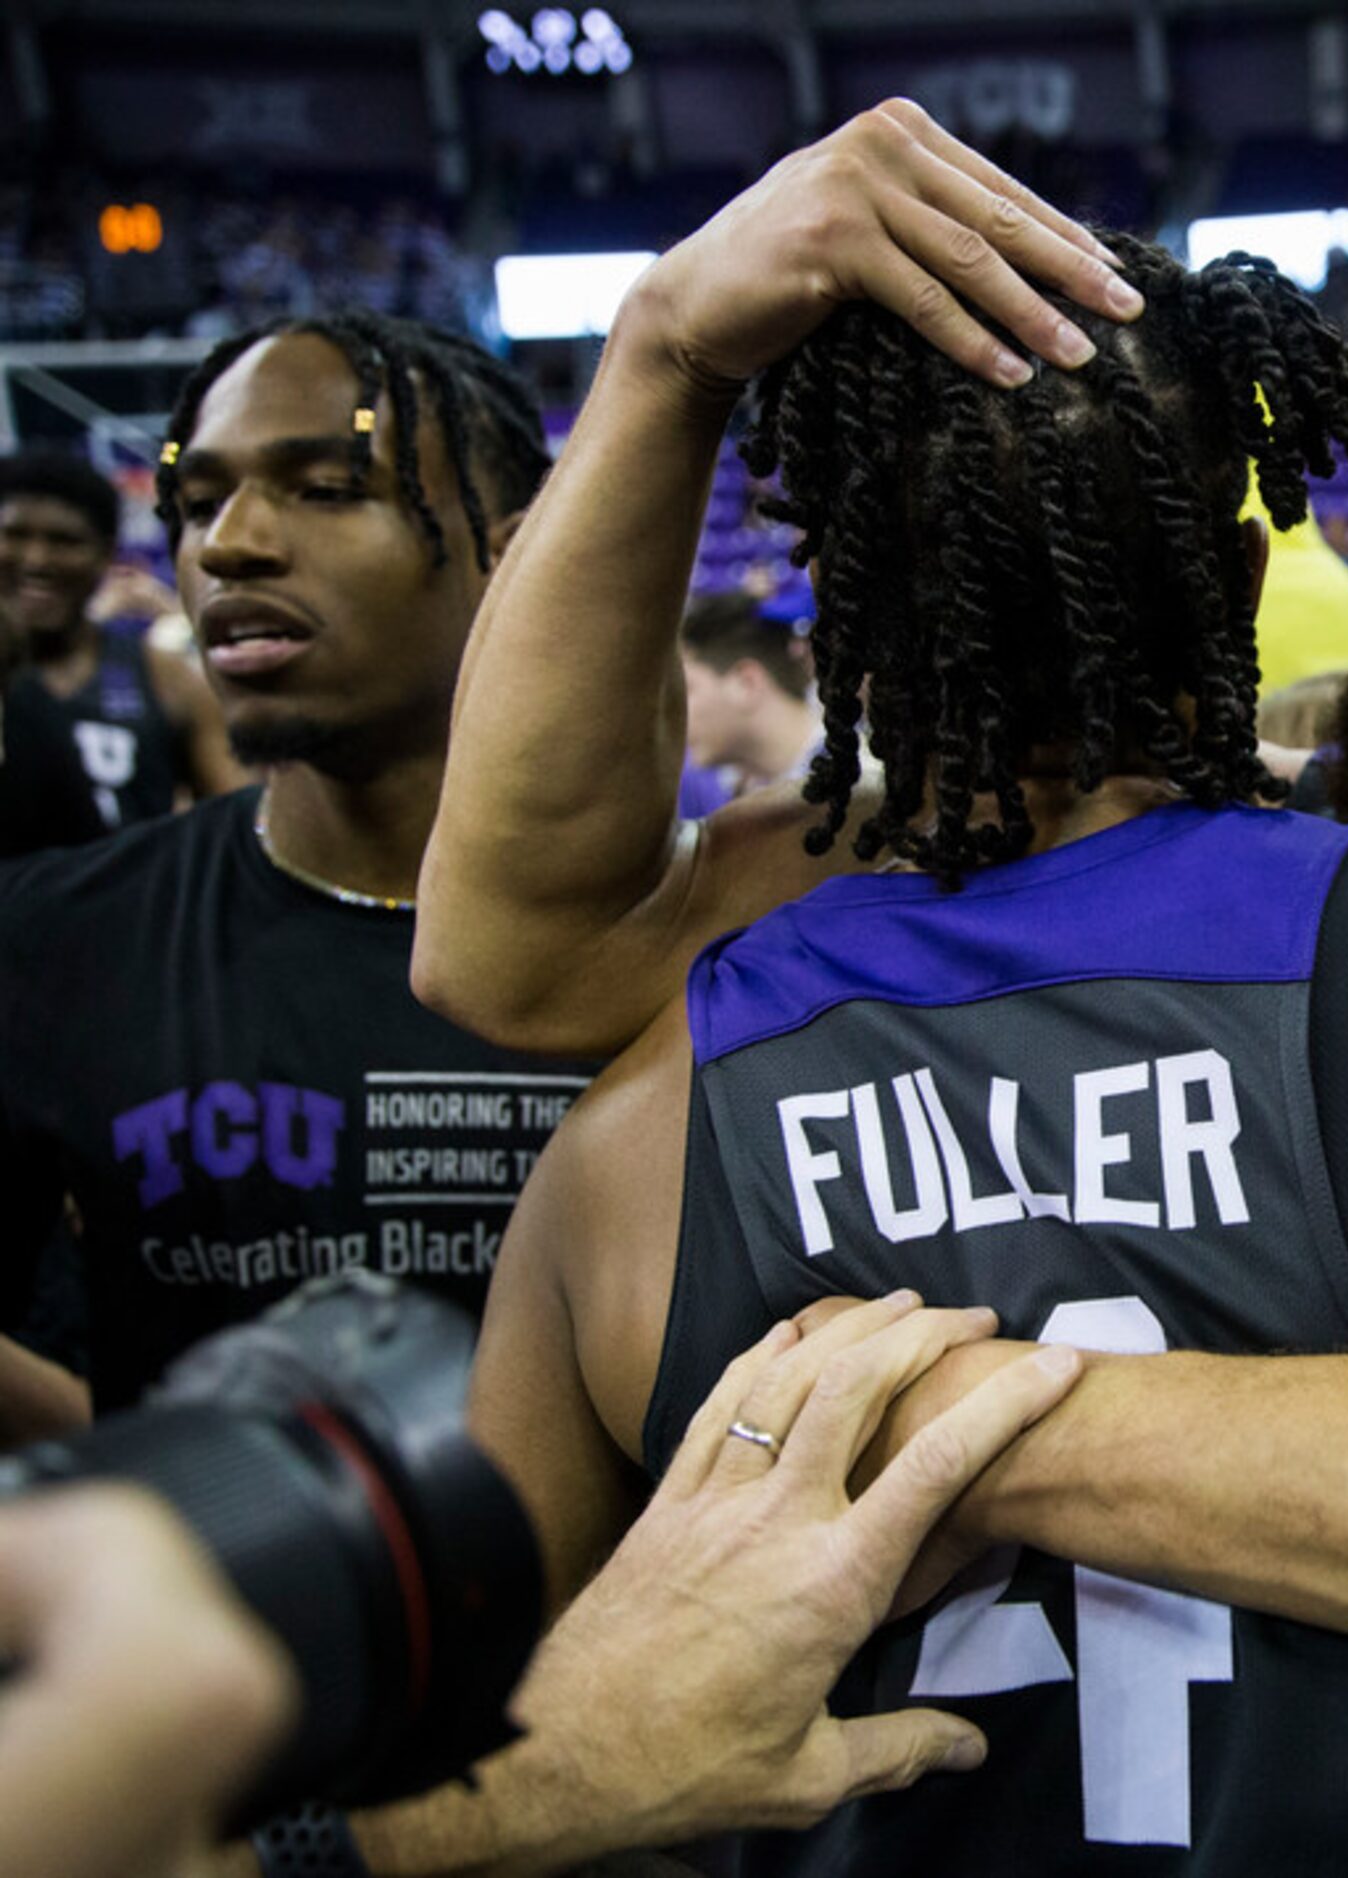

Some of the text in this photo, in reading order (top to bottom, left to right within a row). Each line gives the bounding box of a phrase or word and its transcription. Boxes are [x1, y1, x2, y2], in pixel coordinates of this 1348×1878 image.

[366, 1092, 512, 1129] HONORING
[112, 1080, 345, 1211] TCU
[366, 1148, 508, 1185] INSPIRING
[777, 1048, 1250, 1257] FULLER
[382, 1220, 500, 1274] Black
